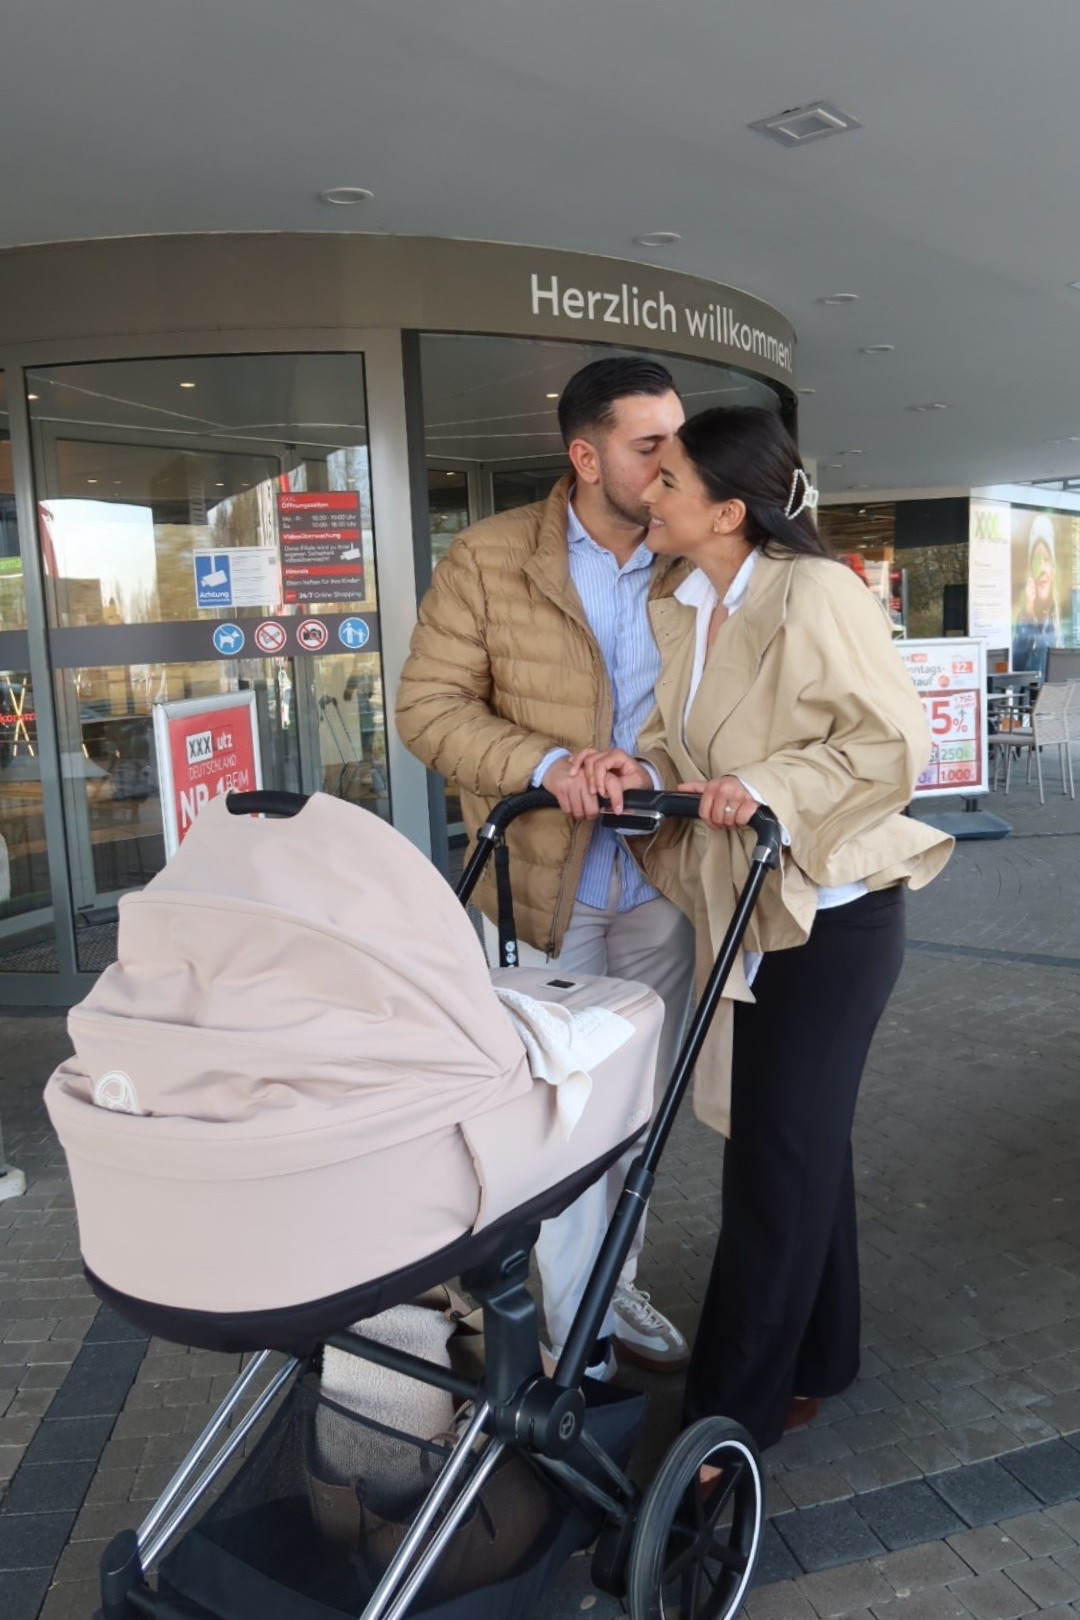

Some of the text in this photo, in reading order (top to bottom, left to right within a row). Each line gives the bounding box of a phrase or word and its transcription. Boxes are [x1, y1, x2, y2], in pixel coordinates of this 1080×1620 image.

[531, 273, 677, 333] Herzlich
[189, 754, 237, 780] DEUTSCHLAND
[225, 768, 249, 791] BEIM
